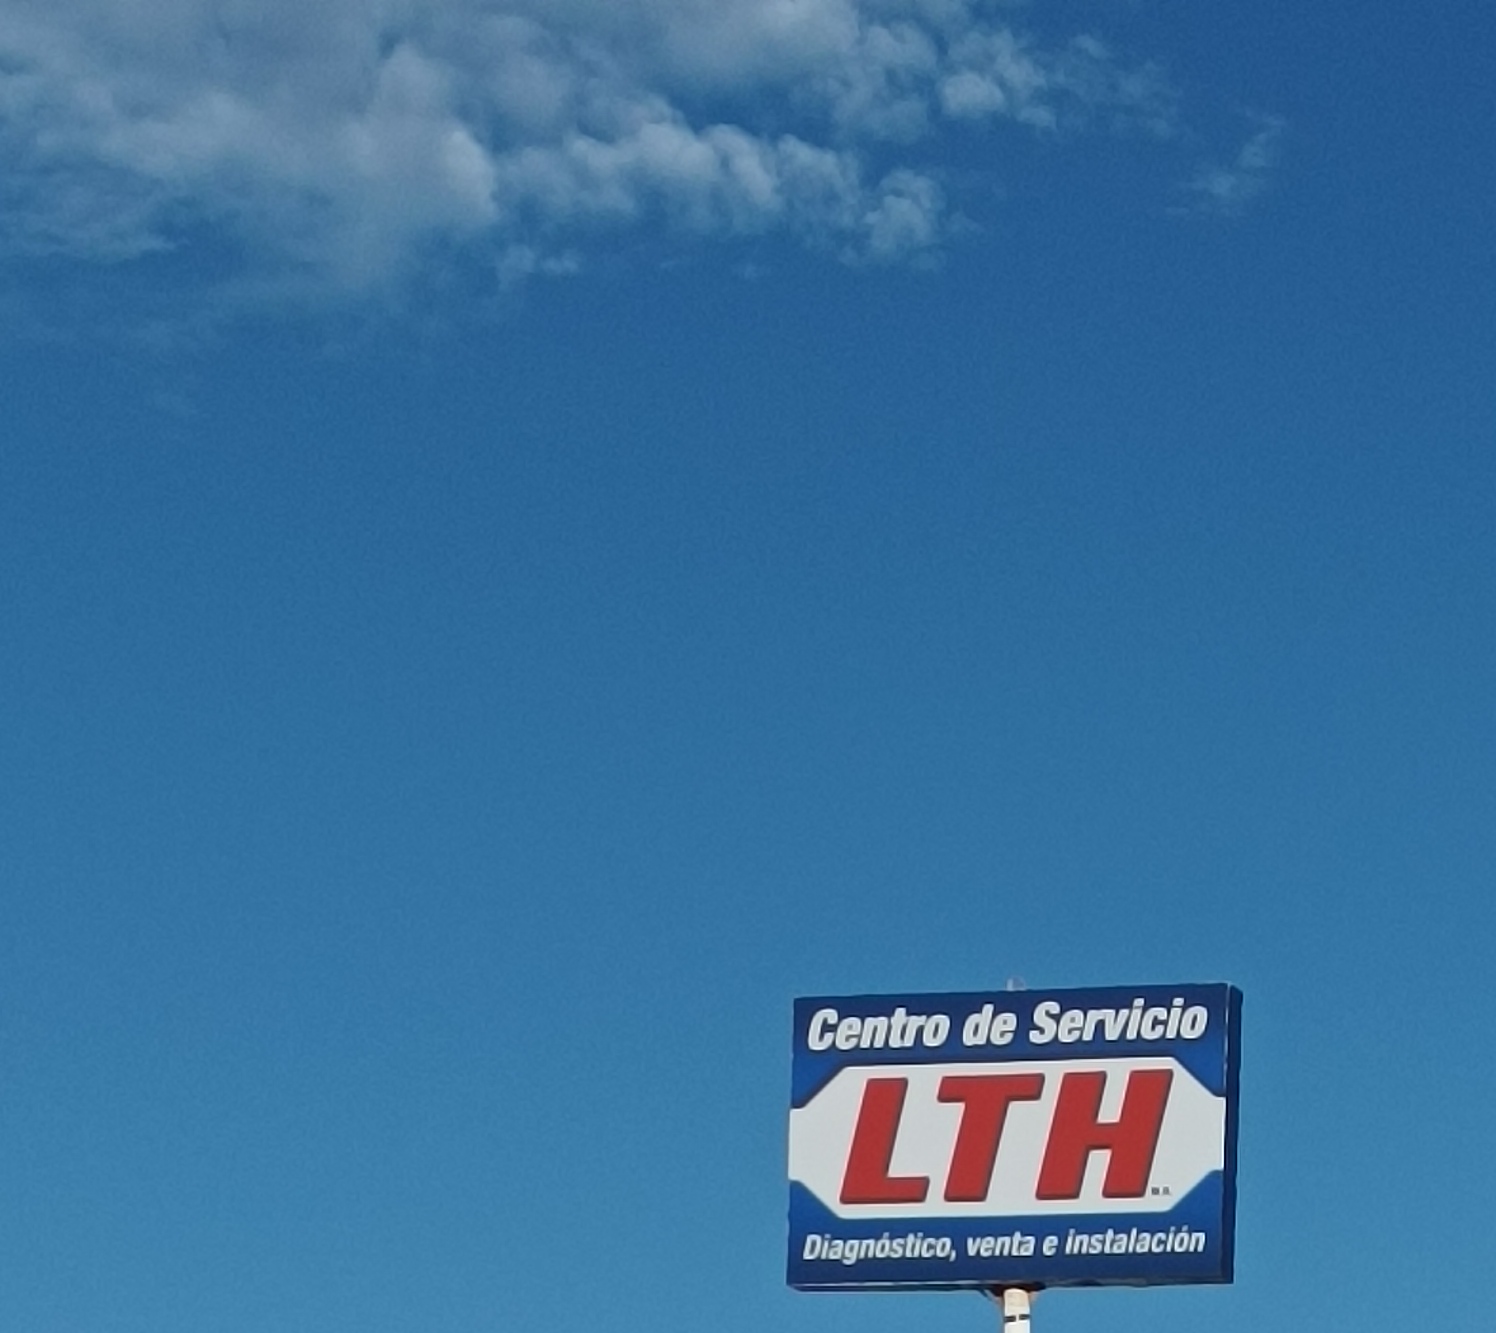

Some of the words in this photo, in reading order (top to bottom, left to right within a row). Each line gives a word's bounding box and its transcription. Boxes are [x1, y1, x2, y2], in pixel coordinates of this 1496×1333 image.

[808, 1006, 950, 1050] Centro
[962, 1003, 1017, 1046] de
[1029, 998, 1208, 1044] Servicio
[839, 1068, 1174, 1204] LTH
[803, 1231, 956, 1266] Diagnóstico,
[967, 1229, 1034, 1257] venta
[1042, 1235, 1057, 1256] e
[1065, 1226, 1206, 1255] instalación
